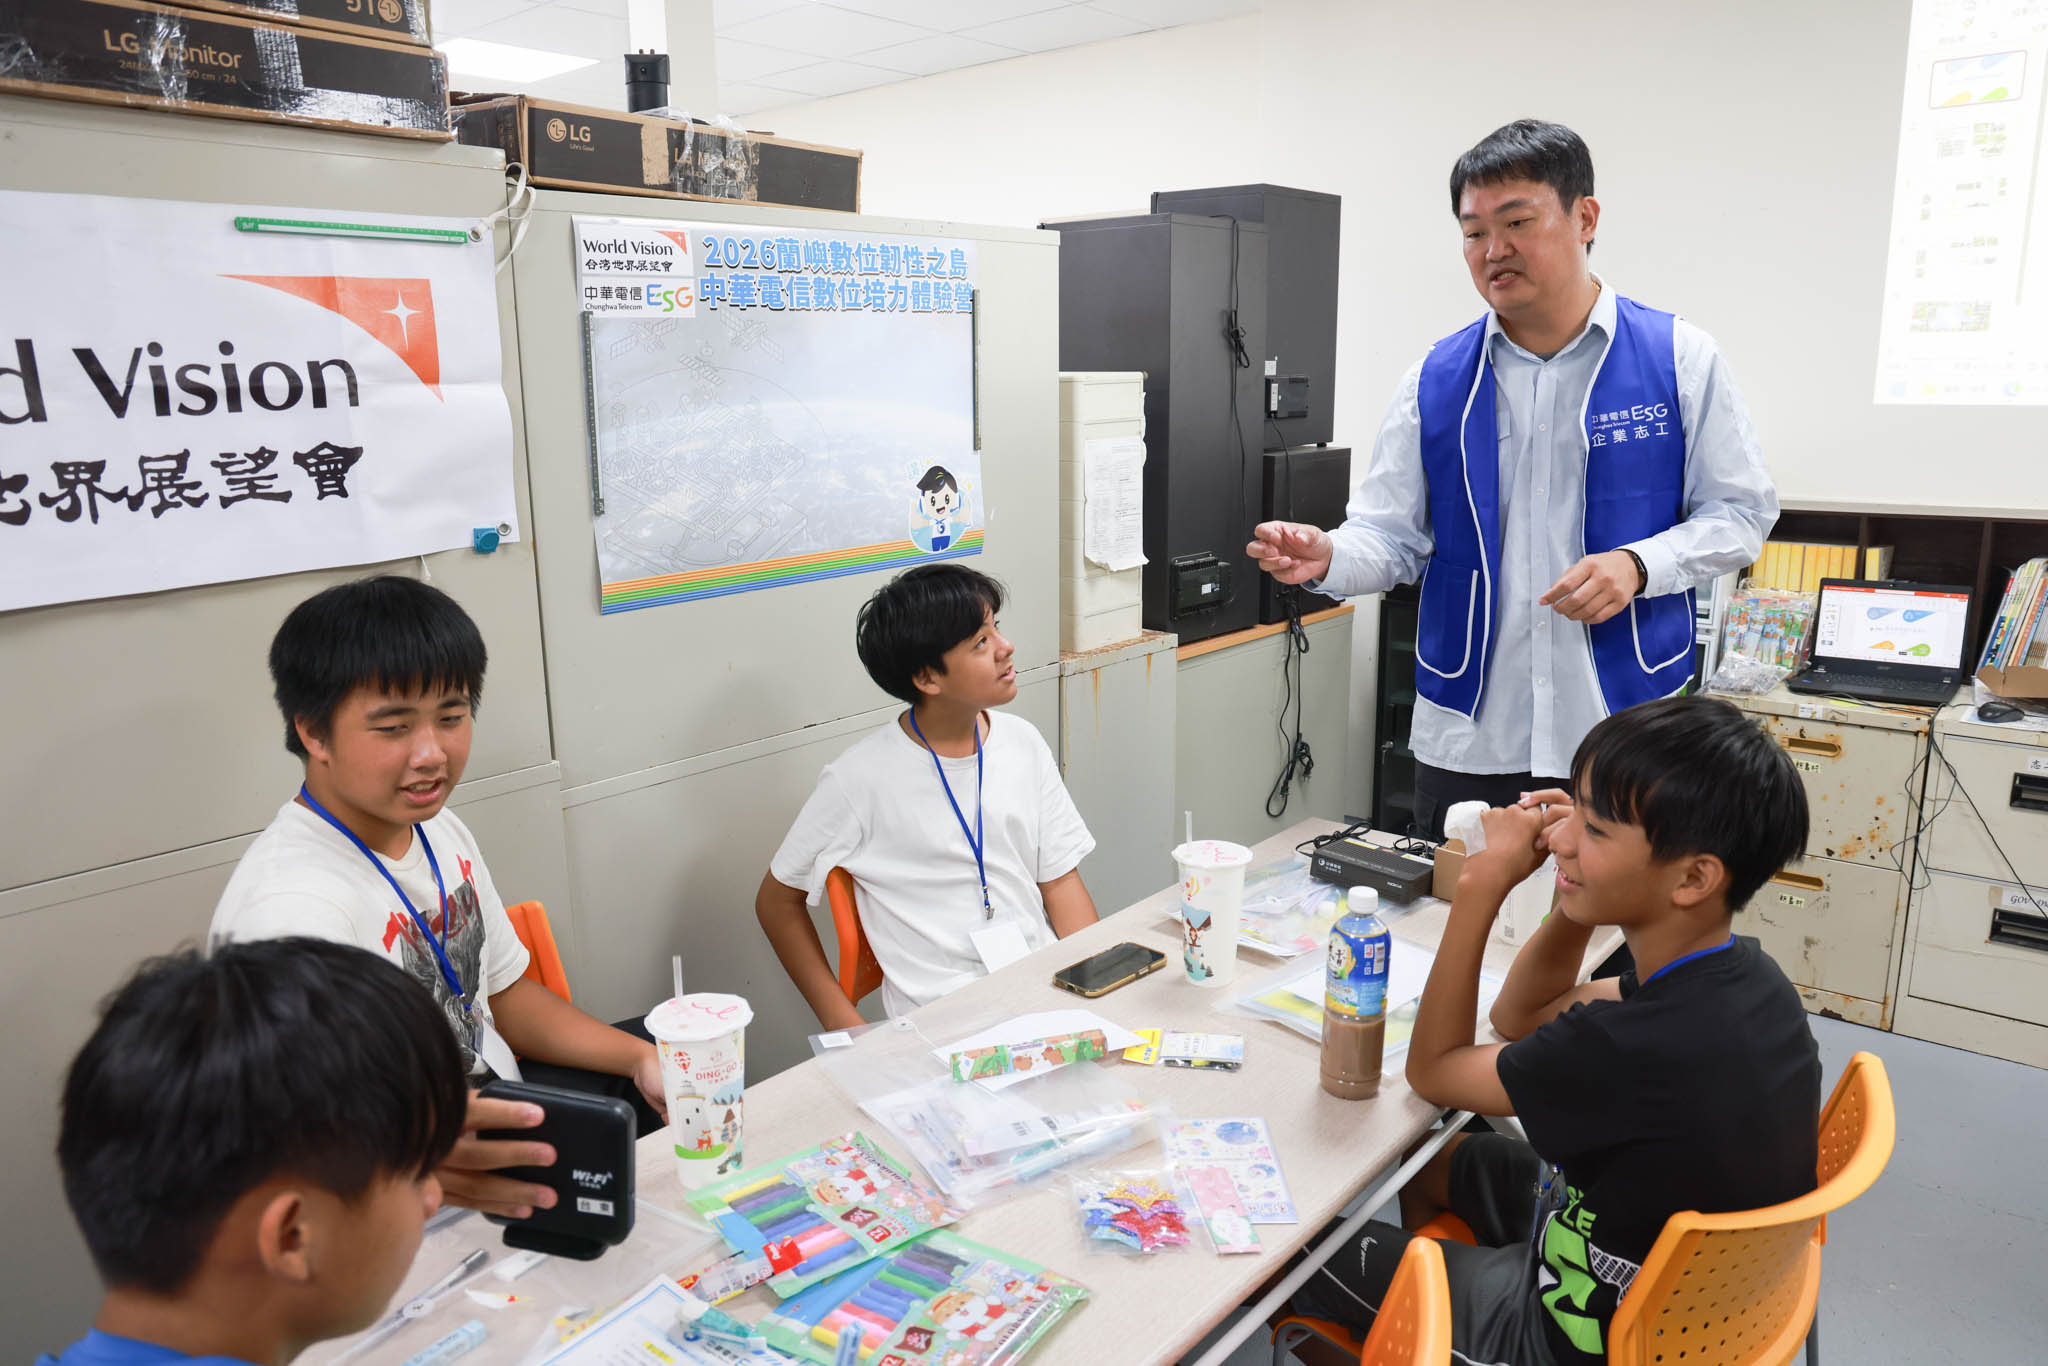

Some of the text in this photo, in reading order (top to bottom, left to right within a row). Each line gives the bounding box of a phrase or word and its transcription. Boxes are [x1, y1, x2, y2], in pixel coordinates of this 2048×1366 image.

[104, 29, 140, 54] LG
[569, 124, 591, 142] LG
[583, 239, 673, 255] World Vision
[703, 236, 968, 279] 2026蘭嶼數位韌性之島
[584, 284, 693, 312] 中華電信 ESG
[699, 272, 974, 313] 中華電信數位培力體驗營
[585, 303, 643, 312] Chunghwa Telecom
[71, 340, 360, 420] Vision
[1631, 403, 1668, 422] ESG
[1591, 422, 1669, 447] 企業志工
[572, 1169, 608, 1185] Wi-Fi
